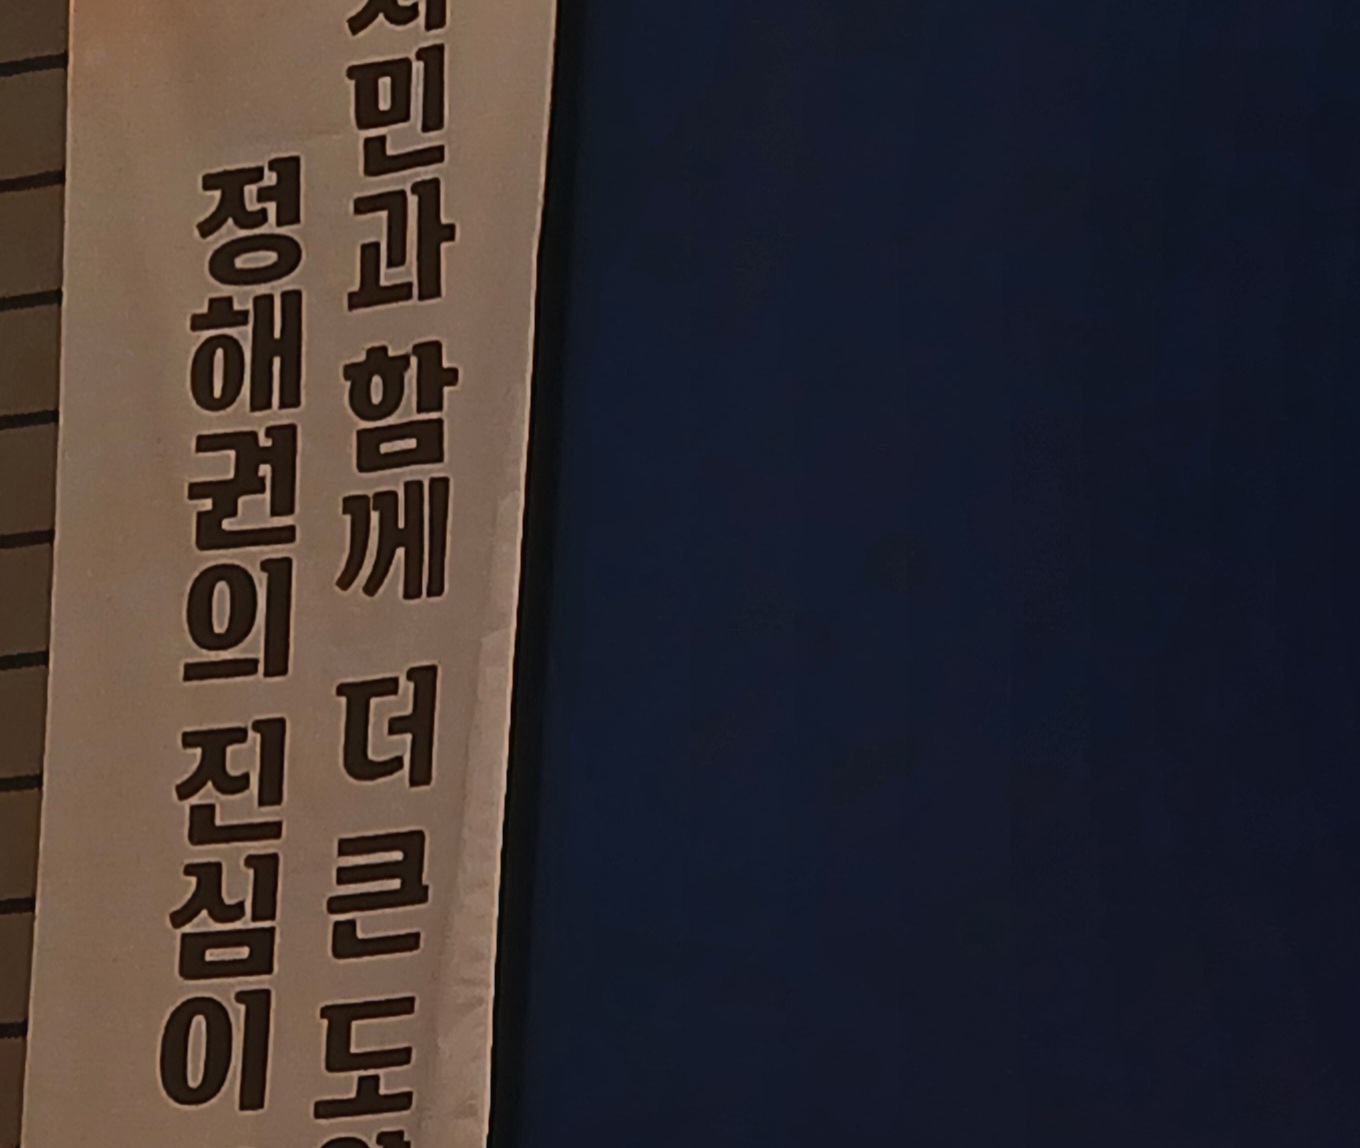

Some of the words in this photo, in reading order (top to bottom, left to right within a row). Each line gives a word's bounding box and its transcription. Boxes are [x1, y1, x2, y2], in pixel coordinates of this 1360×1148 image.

[181, 155, 303, 682] 정해권의
[335, 340, 459, 600] 함께
[335, 664, 438, 788] 더
[159, 717, 288, 1112] 진심이
[326, 829, 429, 959] 큰
